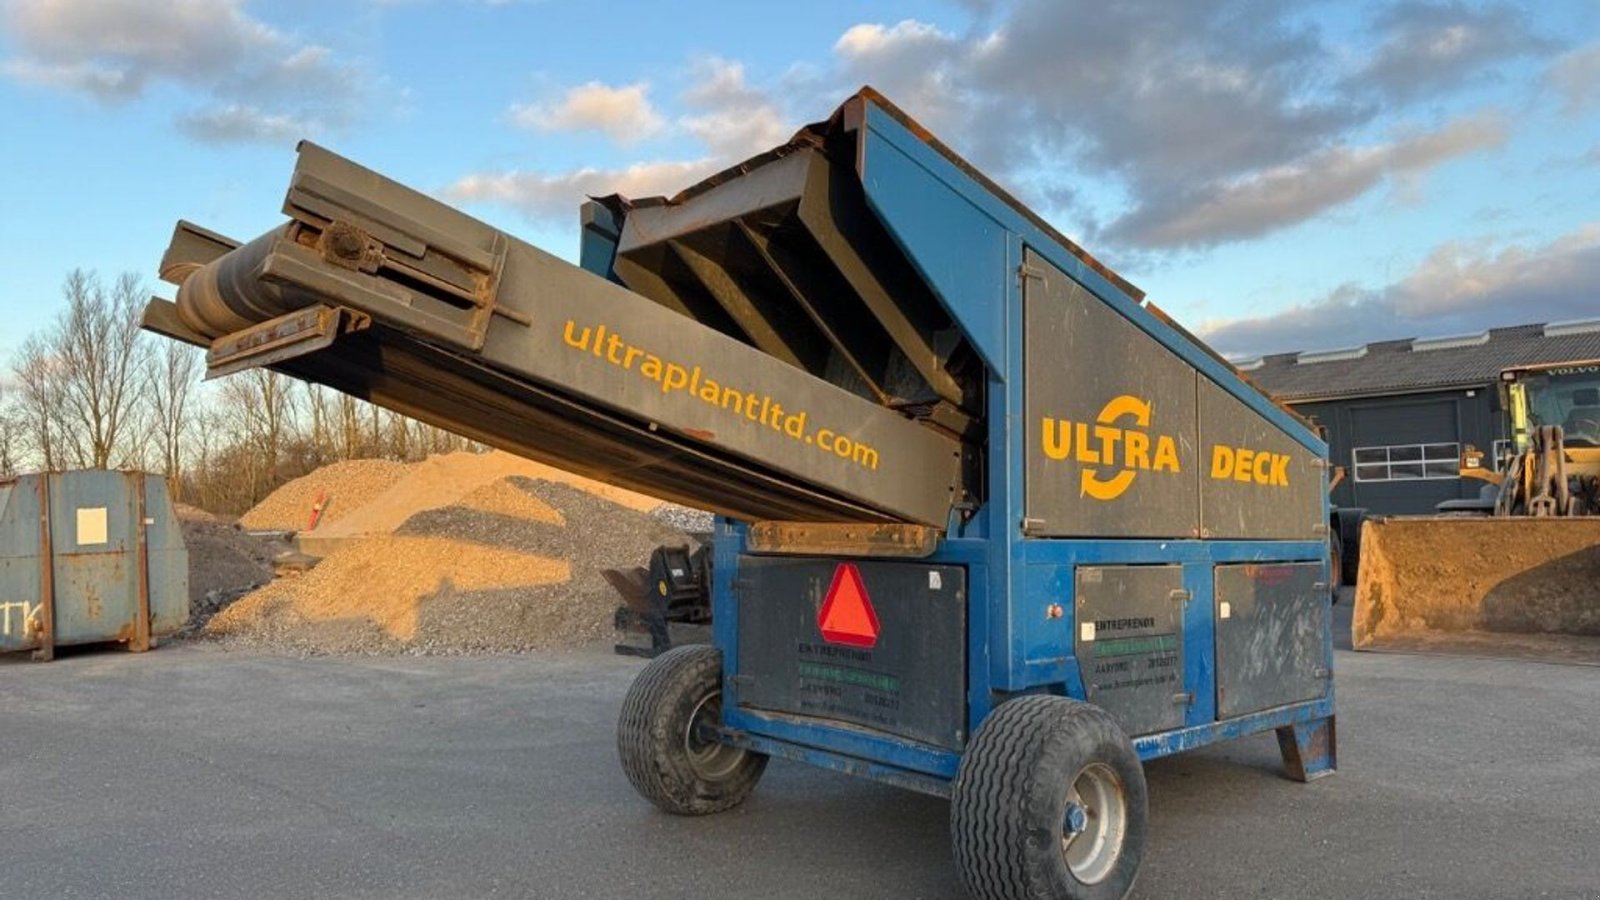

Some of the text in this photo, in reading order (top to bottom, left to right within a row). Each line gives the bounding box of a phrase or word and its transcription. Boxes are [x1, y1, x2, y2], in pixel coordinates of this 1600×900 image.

[563, 319, 880, 471] ultraplantltd.com
[1548, 366, 1599, 376] VOLVO
[1042, 417, 1291, 487] ULTRA DECK
